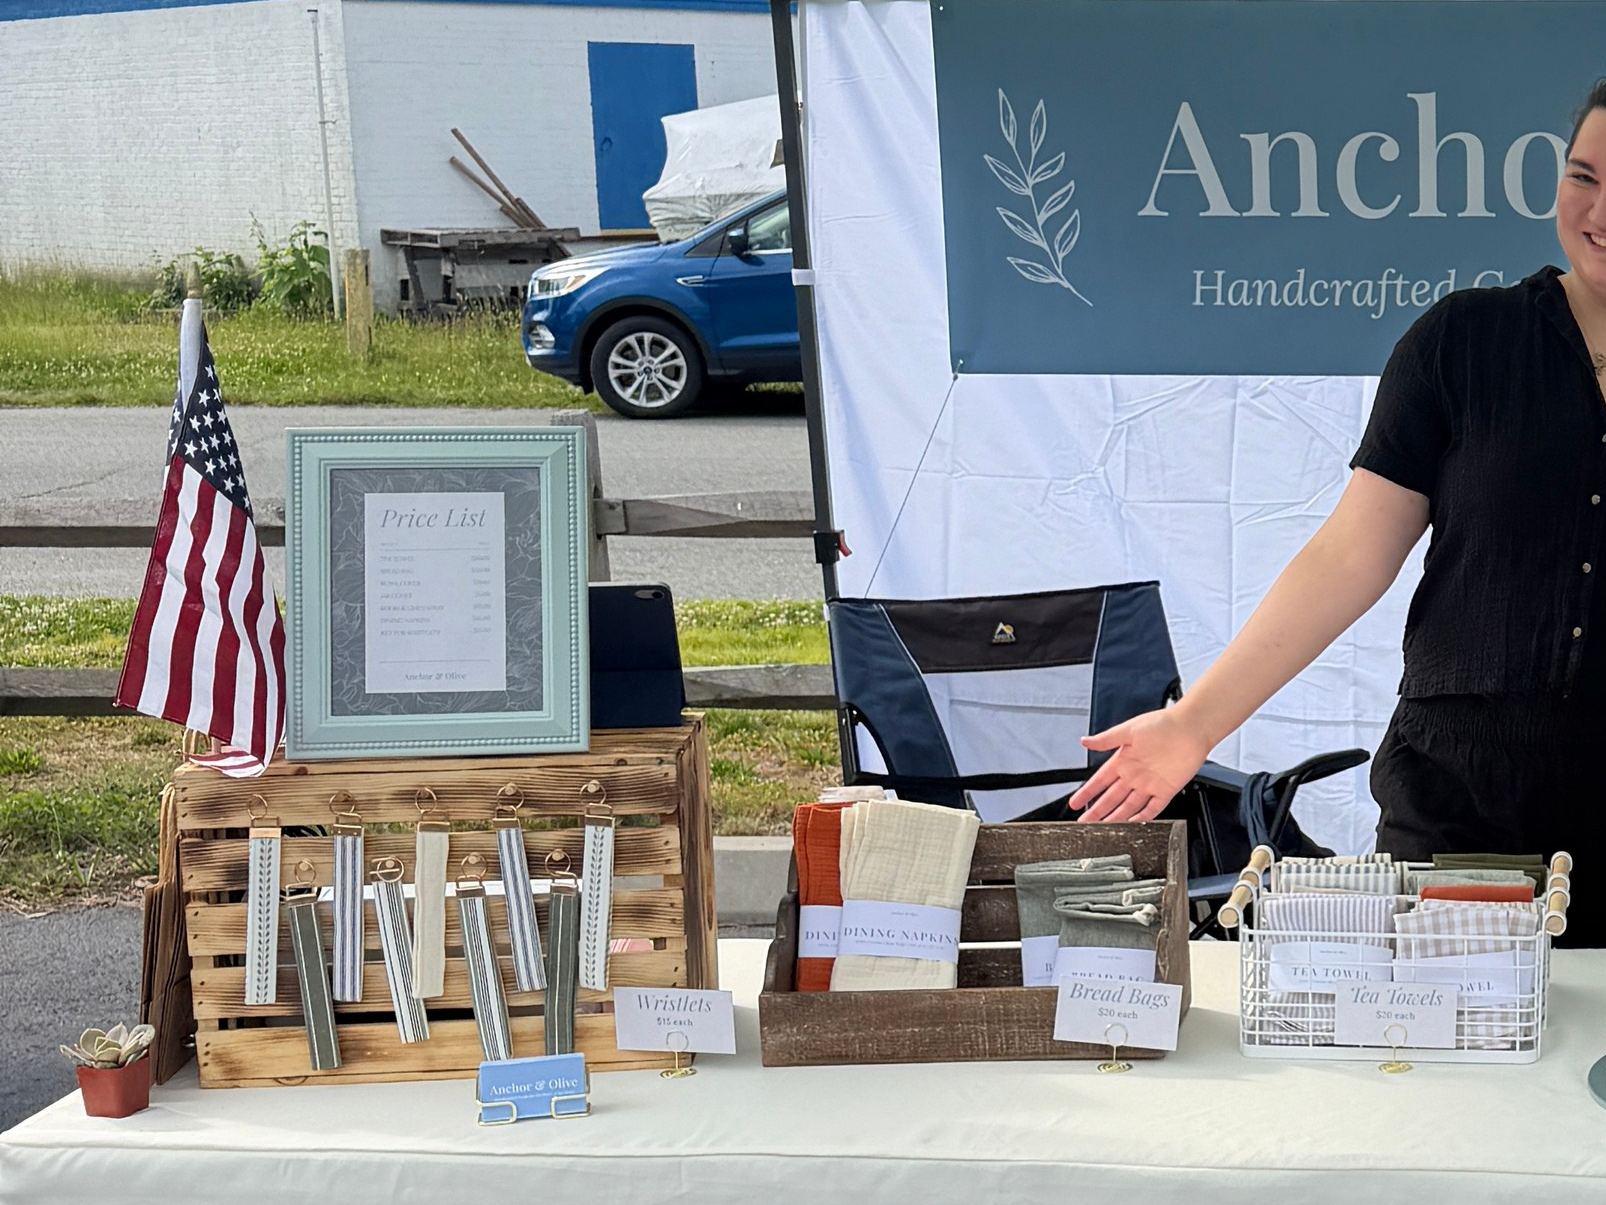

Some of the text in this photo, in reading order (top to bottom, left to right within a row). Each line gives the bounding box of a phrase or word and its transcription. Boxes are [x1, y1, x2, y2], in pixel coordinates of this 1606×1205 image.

[1137, 91, 1567, 220] Ancho
[1192, 267, 1457, 320] Handcrafted
[380, 507, 486, 528] Price List
[804, 930, 837, 941] DINI
[843, 926, 895, 939] DINING
[901, 930, 958, 946] NAPKINS
[1291, 966, 1372, 981] TEA TOWEL
[1069, 982, 1171, 1010] Bread Bags
[1350, 985, 1443, 1007] Tea Towels
[1457, 981, 1494, 992] OWEL
[637, 994, 713, 1013] Wristlets
[657, 1017, 693, 1026] $15 each
[1097, 1007, 1138, 1020] $20 each
[1376, 1010, 1416, 1020] $20 each
[490, 1082, 533, 1096] Anchor
[534, 1079, 546, 1091] &
[548, 1077, 579, 1090] Olive
